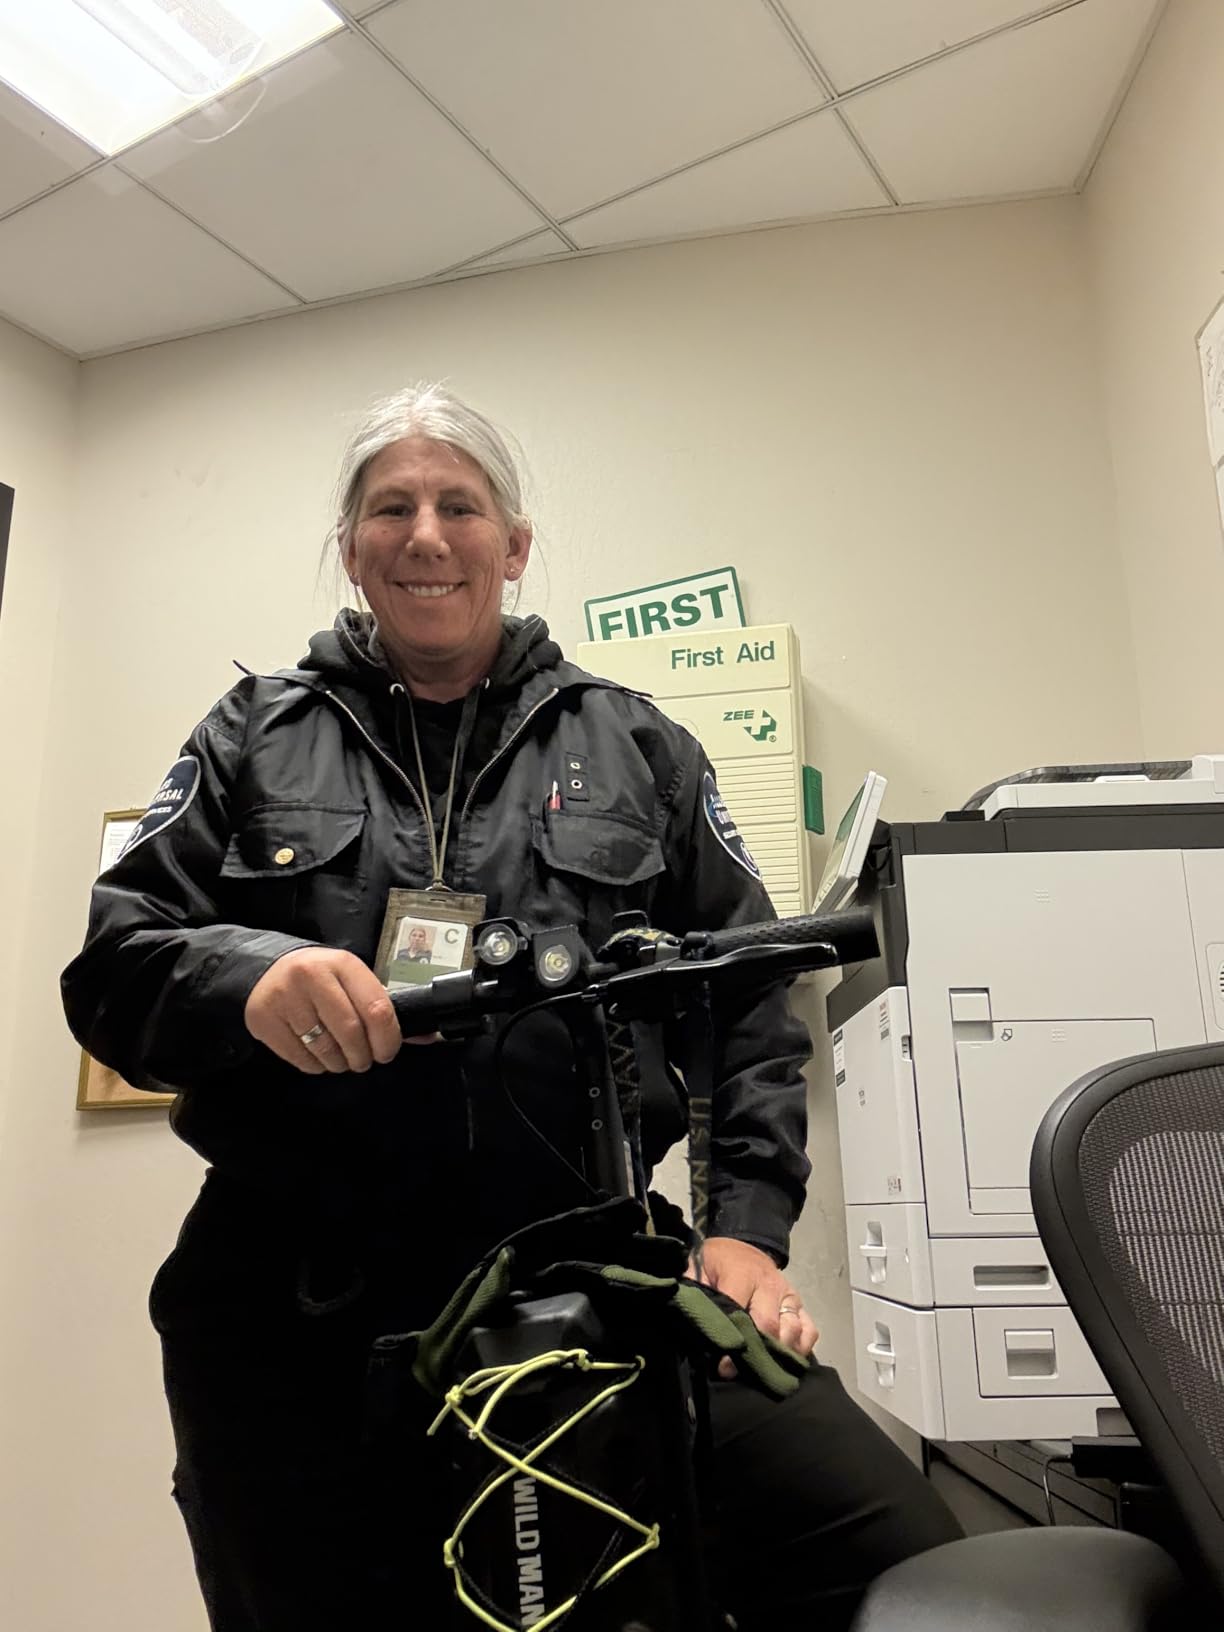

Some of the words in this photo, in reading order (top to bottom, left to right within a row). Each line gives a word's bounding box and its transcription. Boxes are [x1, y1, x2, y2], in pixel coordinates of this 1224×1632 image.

[598, 583, 729, 641] FIRST
[671, 646, 724, 669] First
[736, 640, 776, 664] Aid
[723, 709, 755, 721] ZEE
[445, 928, 460, 944] C
[513, 1477, 540, 1551] WILD
[516, 1554, 545, 1626] MAN
